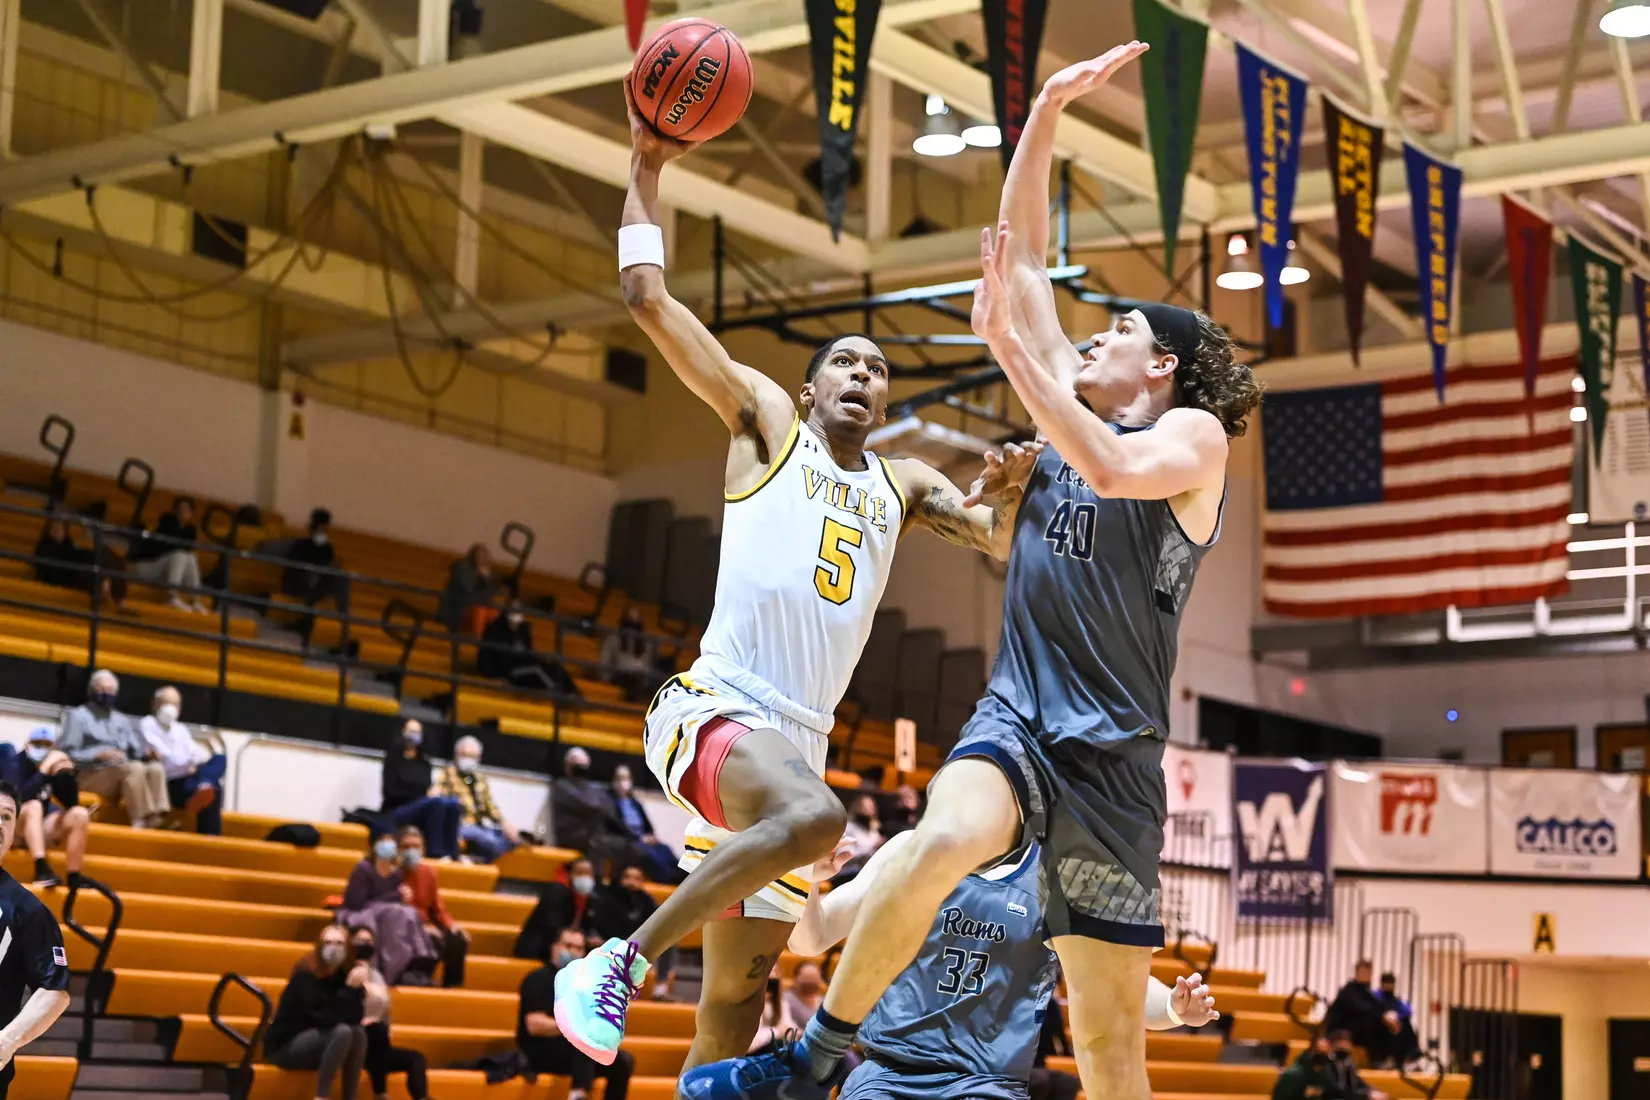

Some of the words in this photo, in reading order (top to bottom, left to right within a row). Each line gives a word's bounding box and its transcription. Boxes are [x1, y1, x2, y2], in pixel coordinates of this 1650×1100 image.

[642, 43, 680, 99] NCAA
[664, 56, 722, 126] Wilson
[801, 464, 888, 534] VILLE
[1043, 499, 1097, 562] 40
[813, 515, 864, 606] 5
[941, 905, 1006, 944] Rams
[1534, 914, 1555, 952] A
[936, 946, 991, 996] 33
